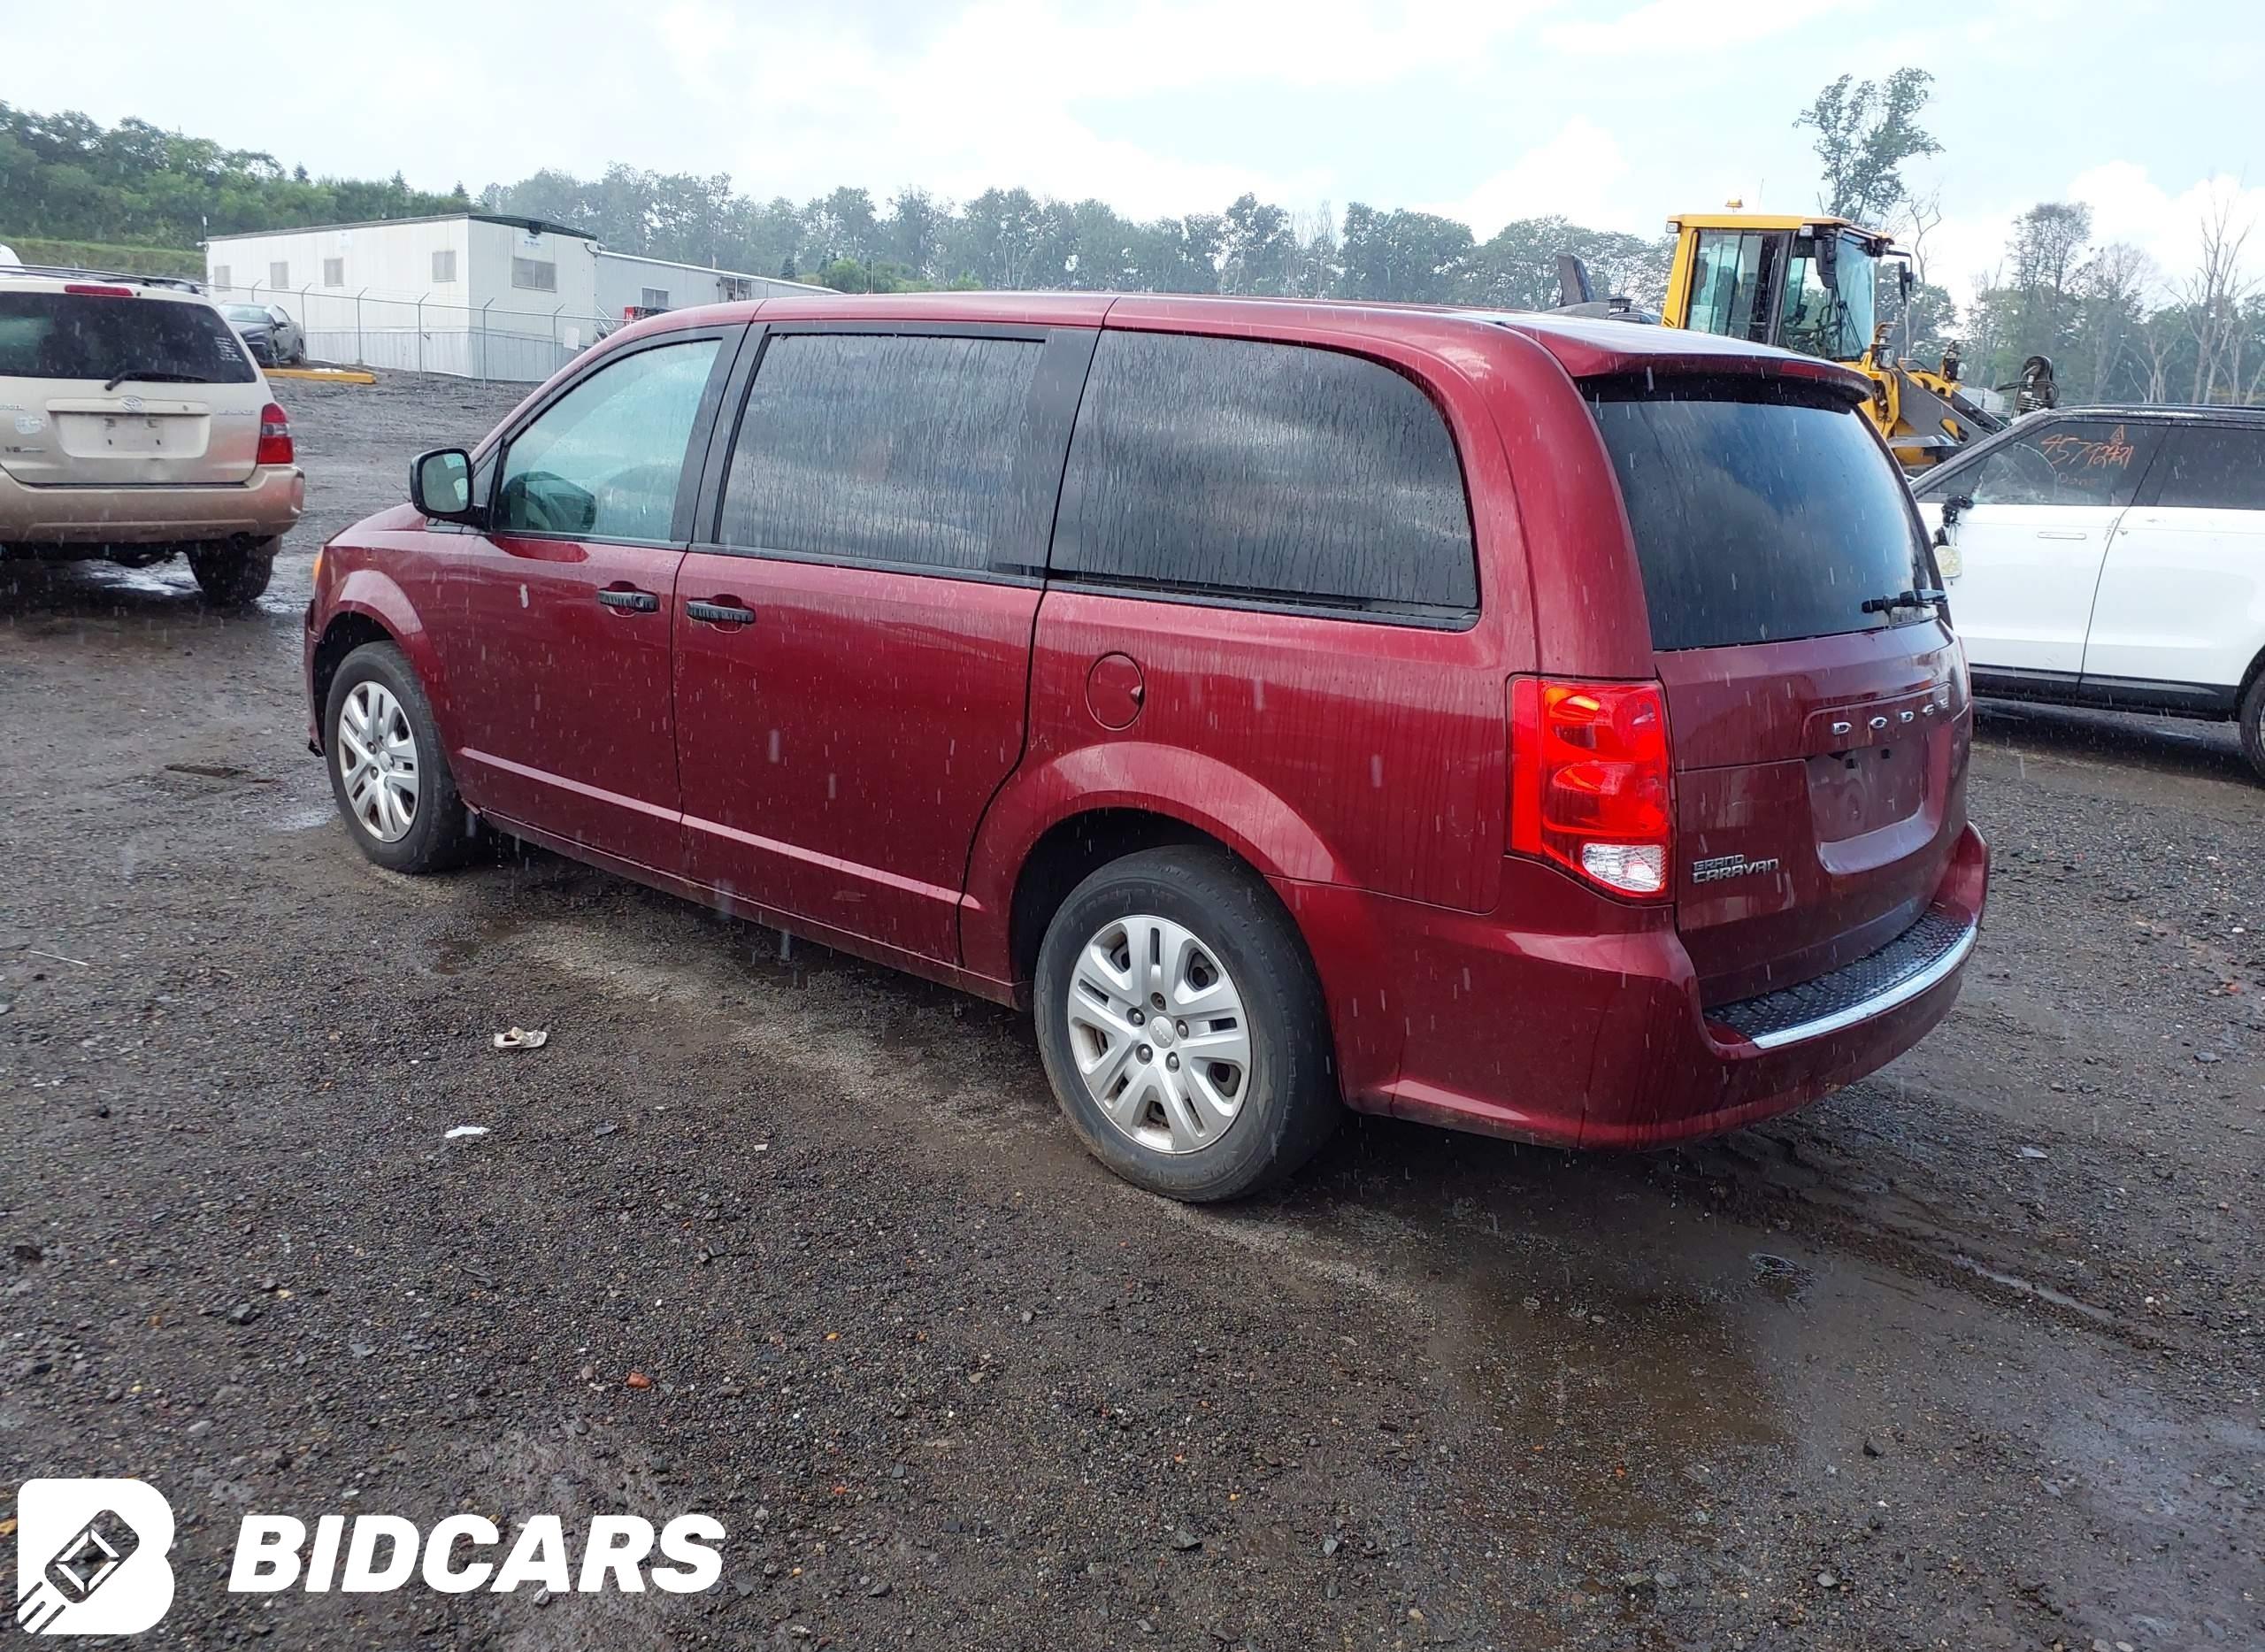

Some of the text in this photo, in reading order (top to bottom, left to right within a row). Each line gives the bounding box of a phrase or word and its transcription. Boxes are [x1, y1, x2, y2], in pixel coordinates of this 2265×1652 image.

[1832, 697, 1949, 735] DODGE
[1693, 854, 1745, 872] GRAND
[1693, 858, 1779, 884] CARAVAN
